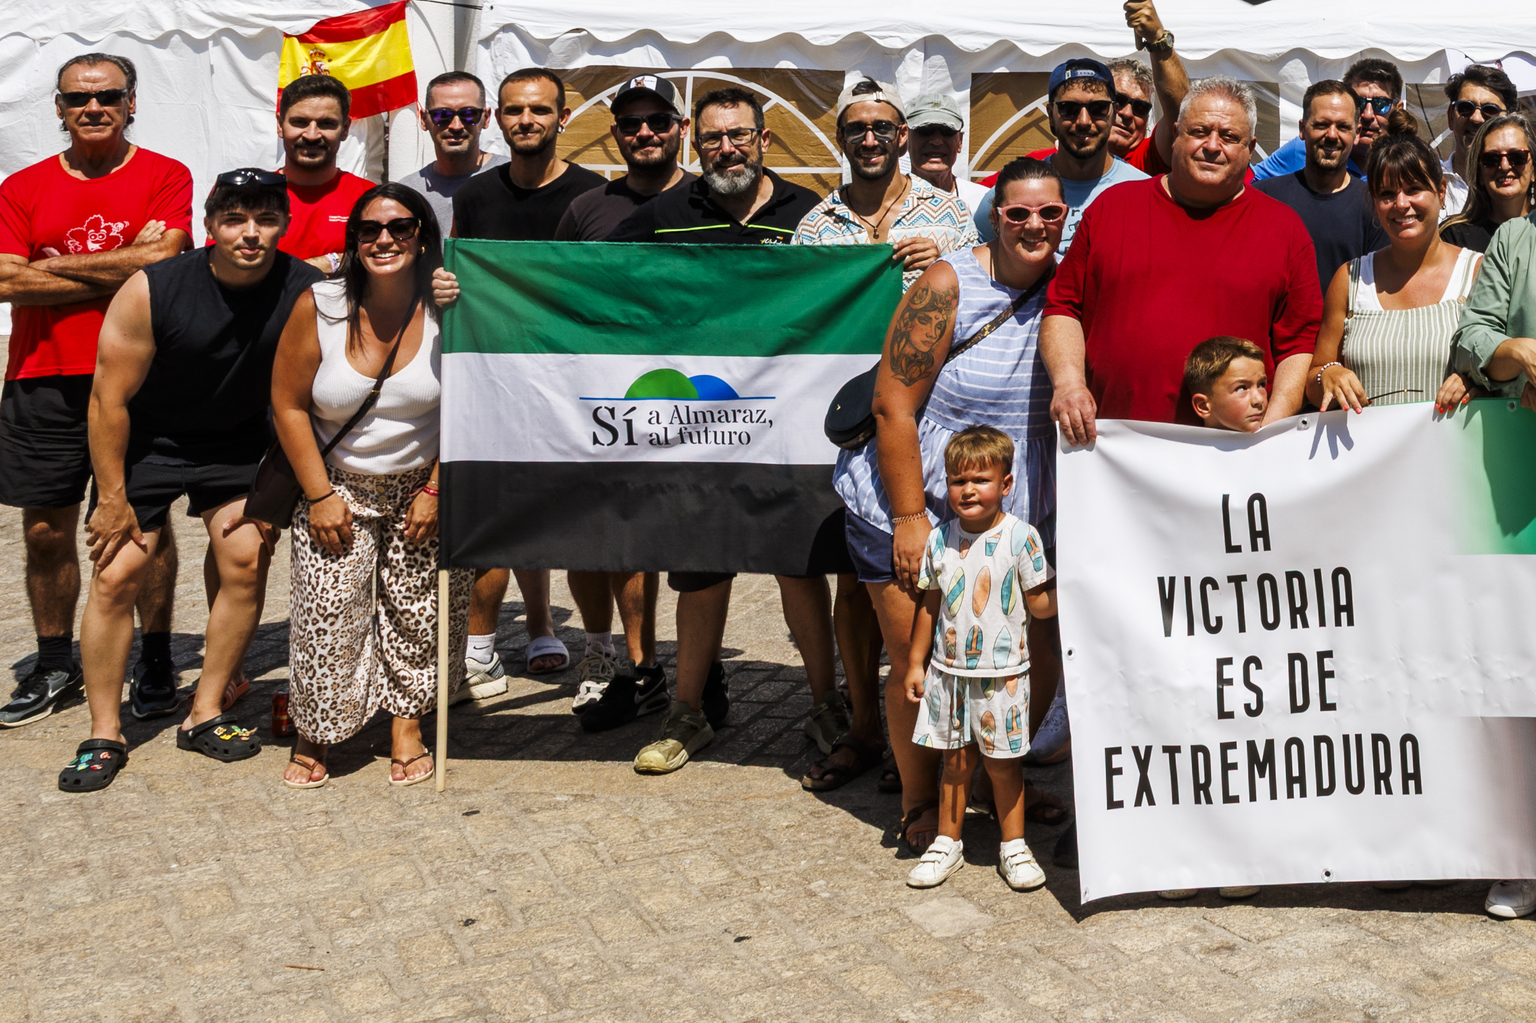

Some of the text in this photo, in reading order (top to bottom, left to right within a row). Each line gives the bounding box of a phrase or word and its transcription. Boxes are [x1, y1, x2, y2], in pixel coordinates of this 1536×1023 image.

[592, 405, 774, 447] Sí a Almaraz,
[648, 426, 752, 447] al futuro
[1221, 492, 1272, 554] LA
[1157, 566, 1355, 638] VICTORIA
[1216, 649, 1337, 720] ES DE
[1104, 732, 1423, 810] EXTREMADURA
